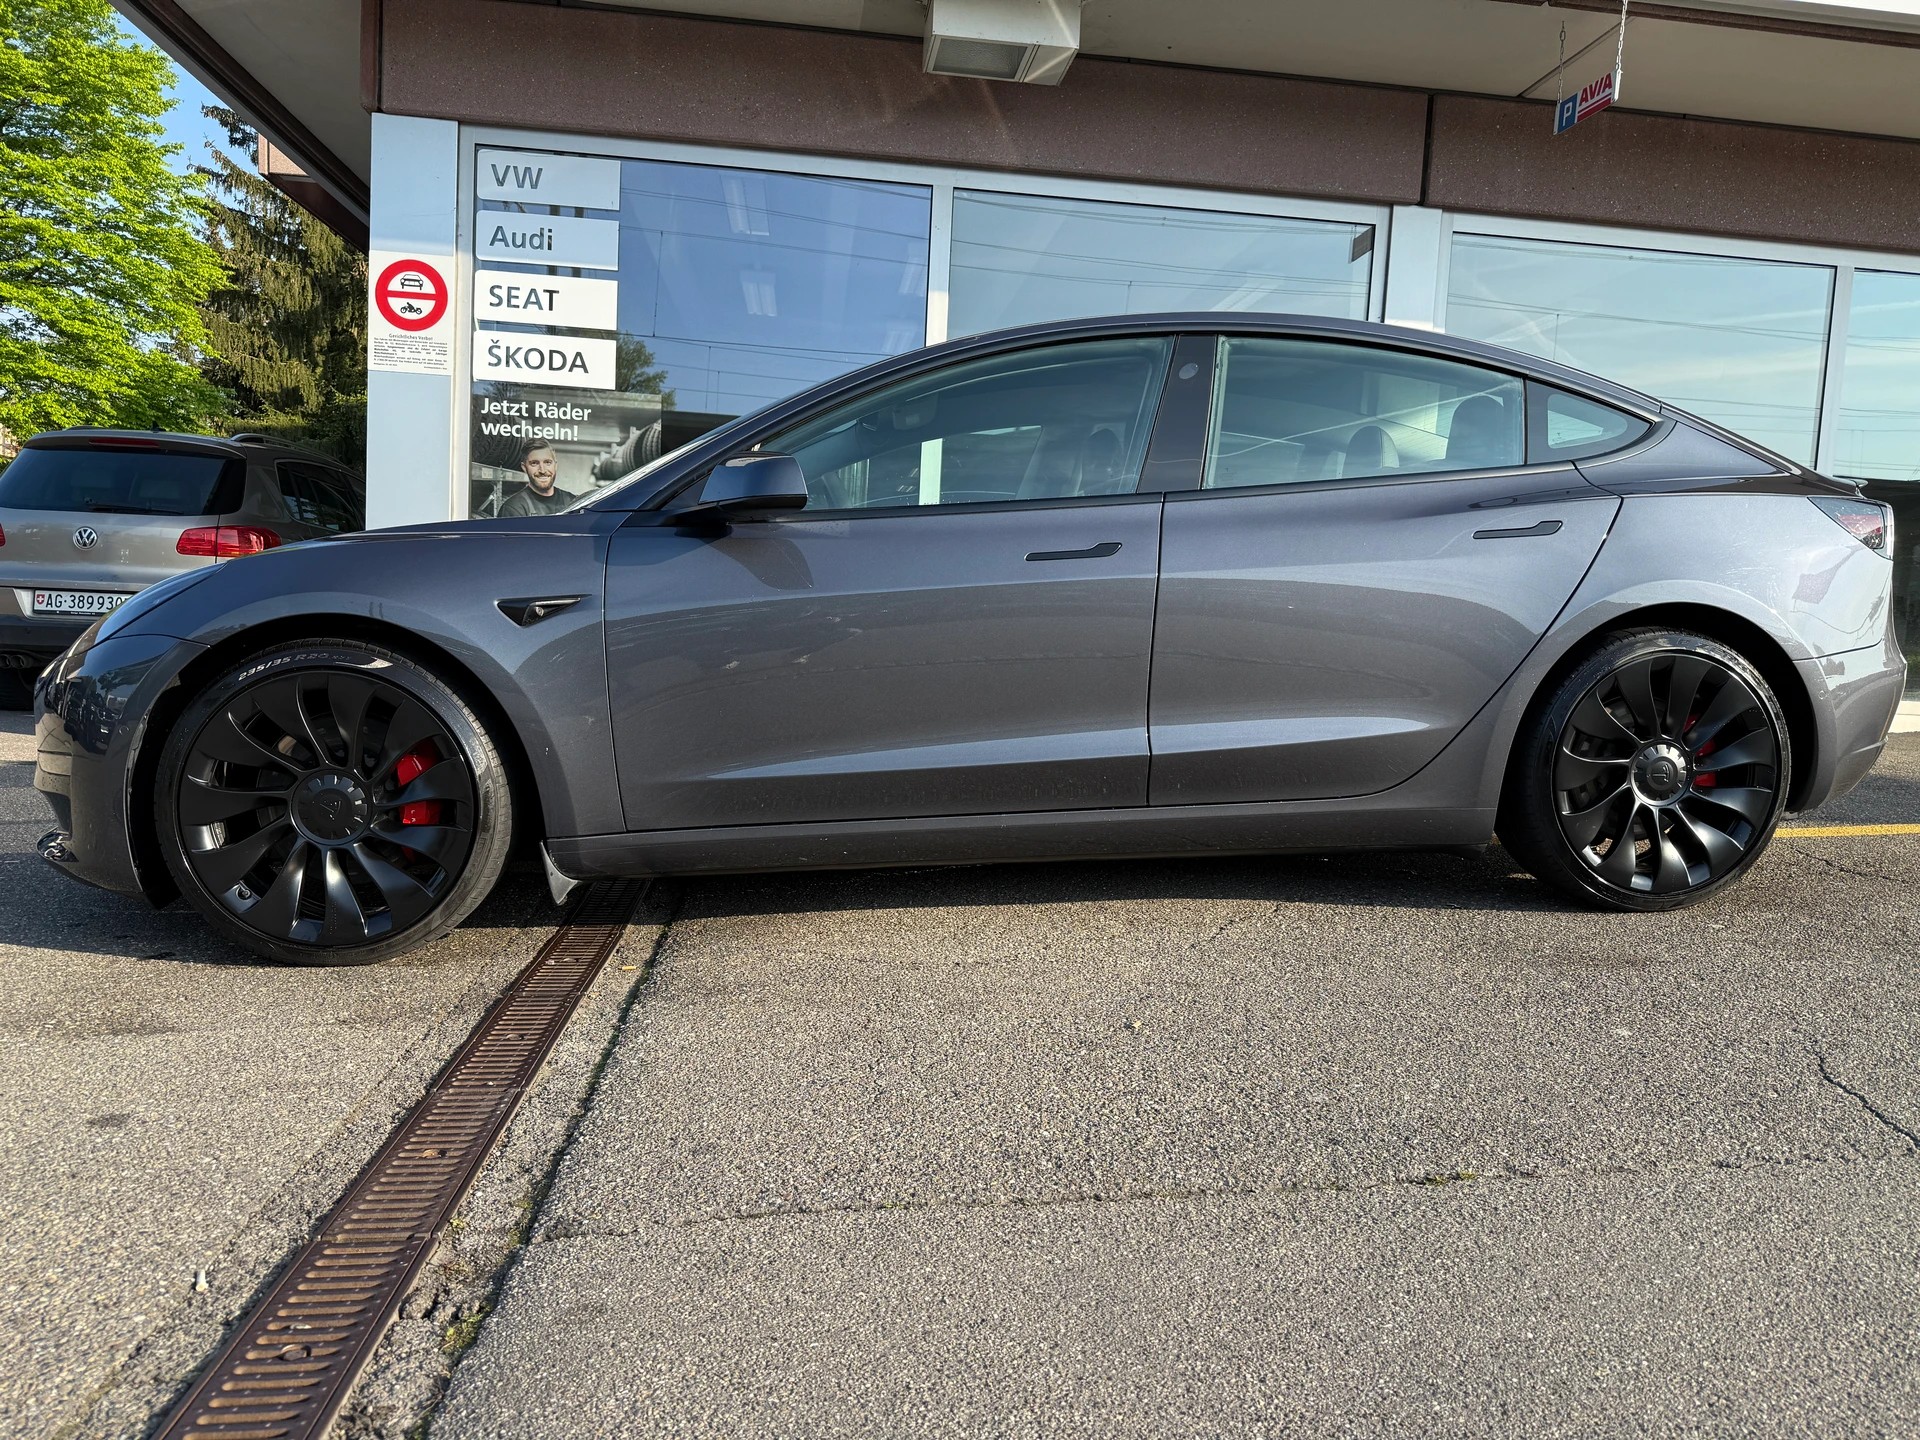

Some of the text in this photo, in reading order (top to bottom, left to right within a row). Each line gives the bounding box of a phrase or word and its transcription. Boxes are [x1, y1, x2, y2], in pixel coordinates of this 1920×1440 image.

[1562, 73, 1612, 126] P AVIA
[490, 163, 543, 189] VW
[489, 225, 553, 251] Audi
[489, 284, 560, 311] SEAT
[487, 338, 590, 374] ŠKODA
[480, 397, 592, 421] Jetzt Räder
[480, 420, 579, 441] wechseln!
